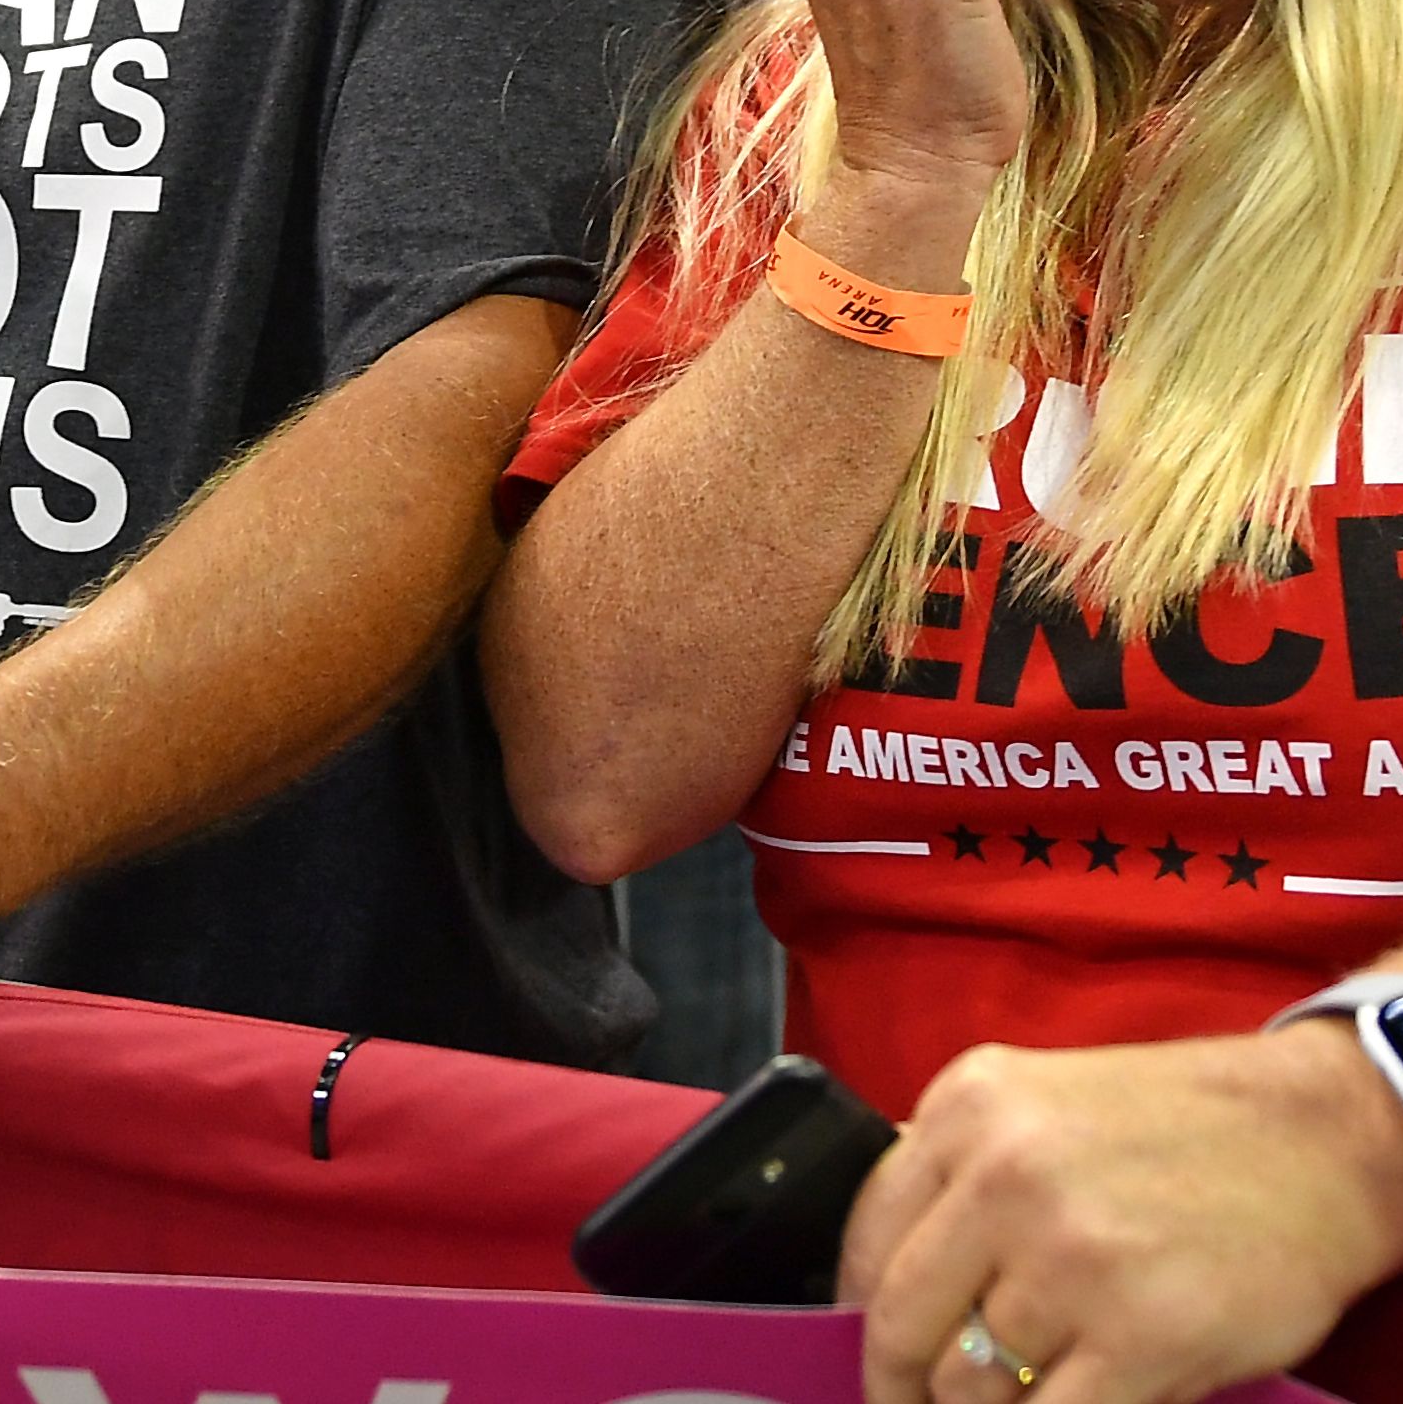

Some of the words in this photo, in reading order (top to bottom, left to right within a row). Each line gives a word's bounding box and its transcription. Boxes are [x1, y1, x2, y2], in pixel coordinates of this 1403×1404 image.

[818, 270, 883, 306] ARENA
[825, 725, 1101, 791] AMERICA
[1115, 740, 1332, 797] GREAT
